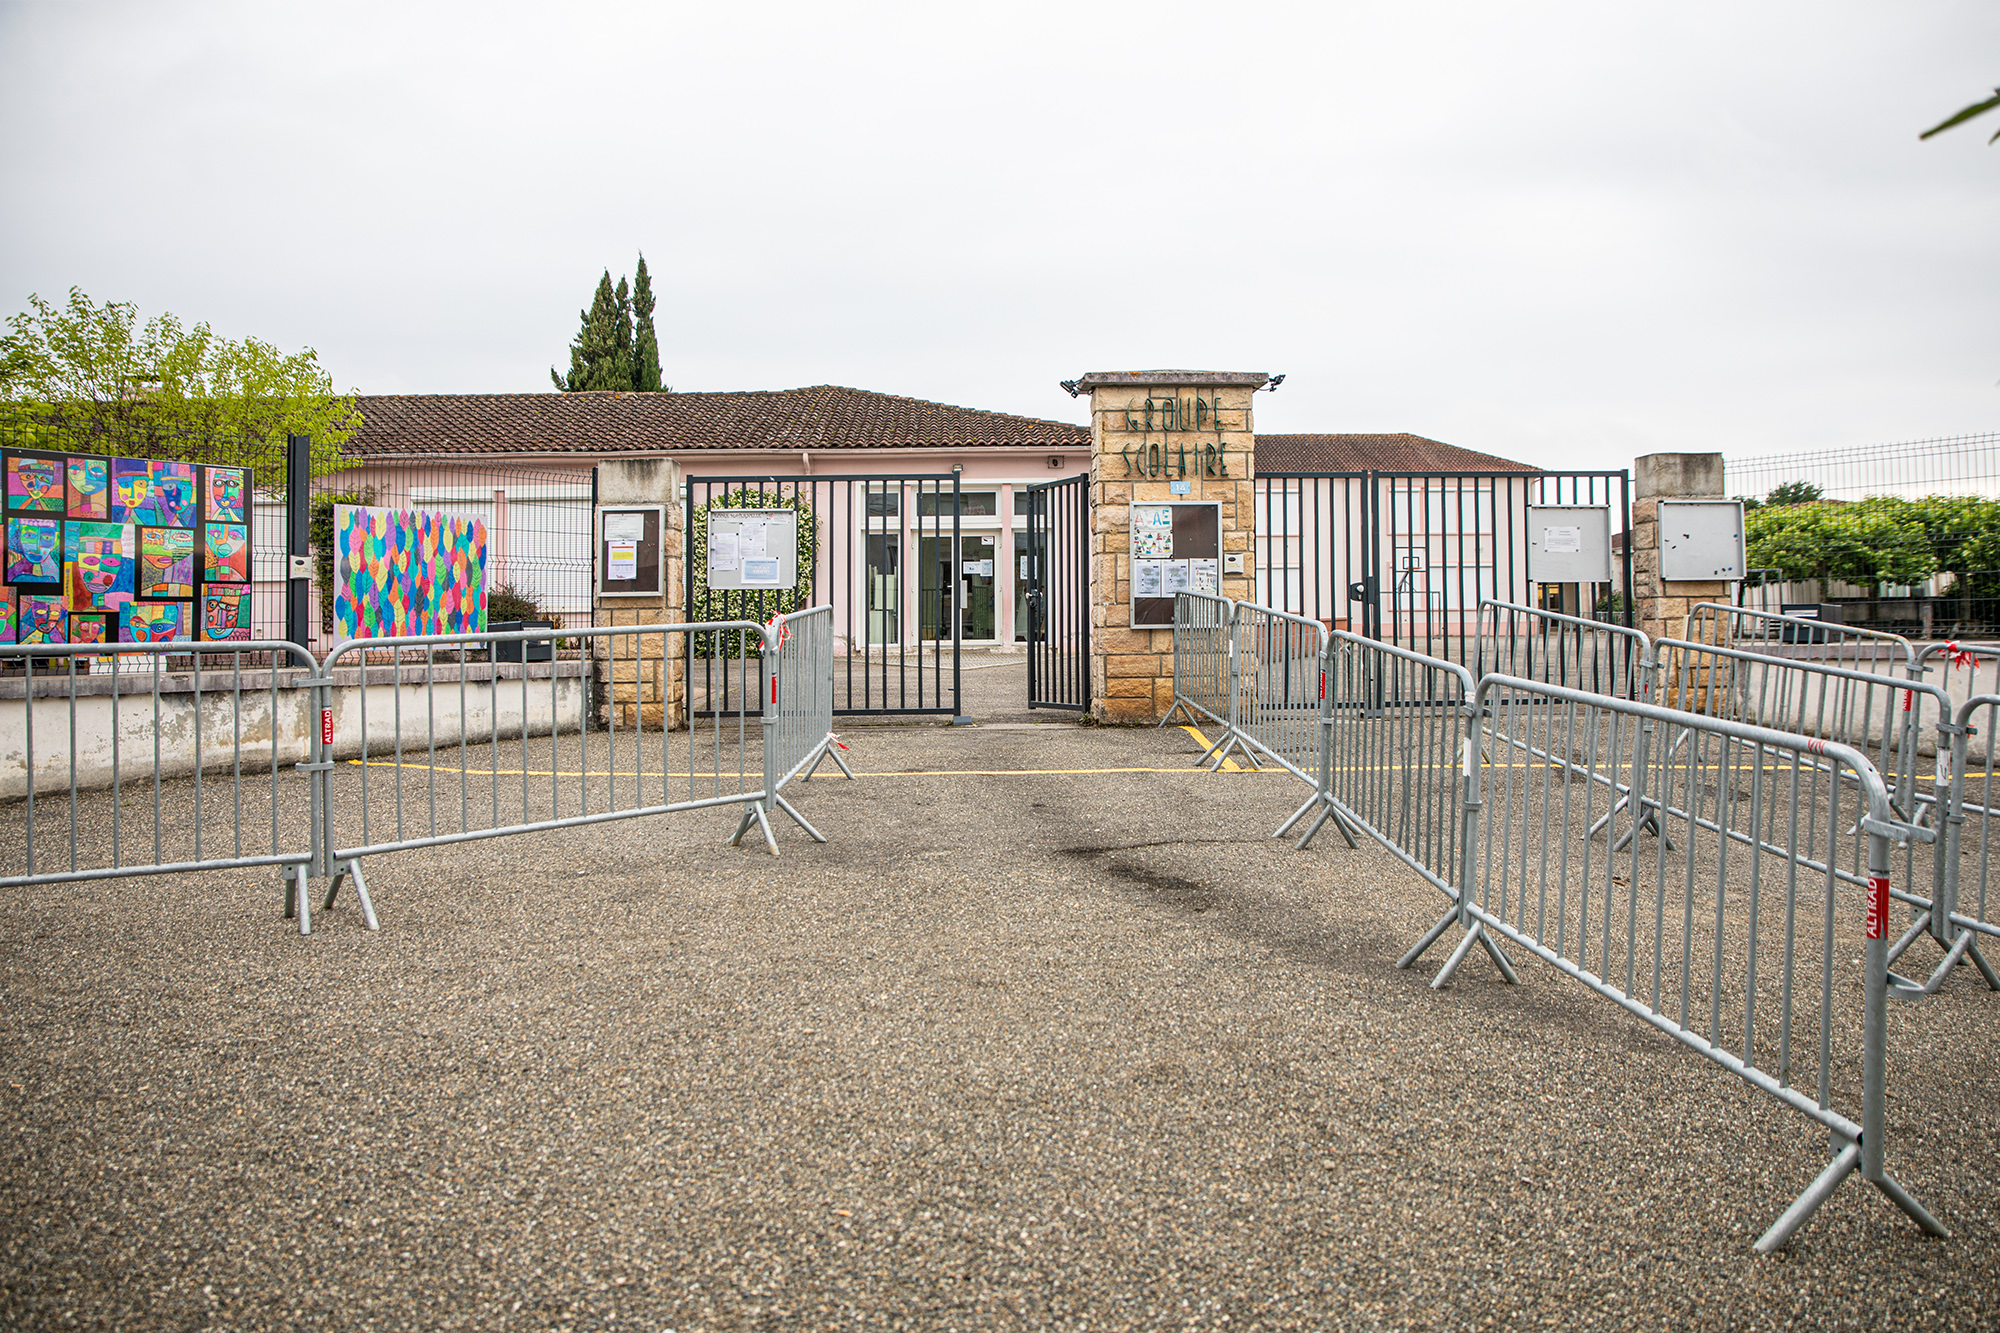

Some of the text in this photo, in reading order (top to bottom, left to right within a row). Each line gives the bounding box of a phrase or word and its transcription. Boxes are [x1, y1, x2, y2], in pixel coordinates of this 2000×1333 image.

[1126, 397, 1225, 431] GROUPE
[1122, 442, 1230, 477] SCOLAIRE
[1175, 483, 1187, 492] 14
[324, 710, 332, 743] ALTRAD
[1867, 878, 1878, 938] ALTRAD
